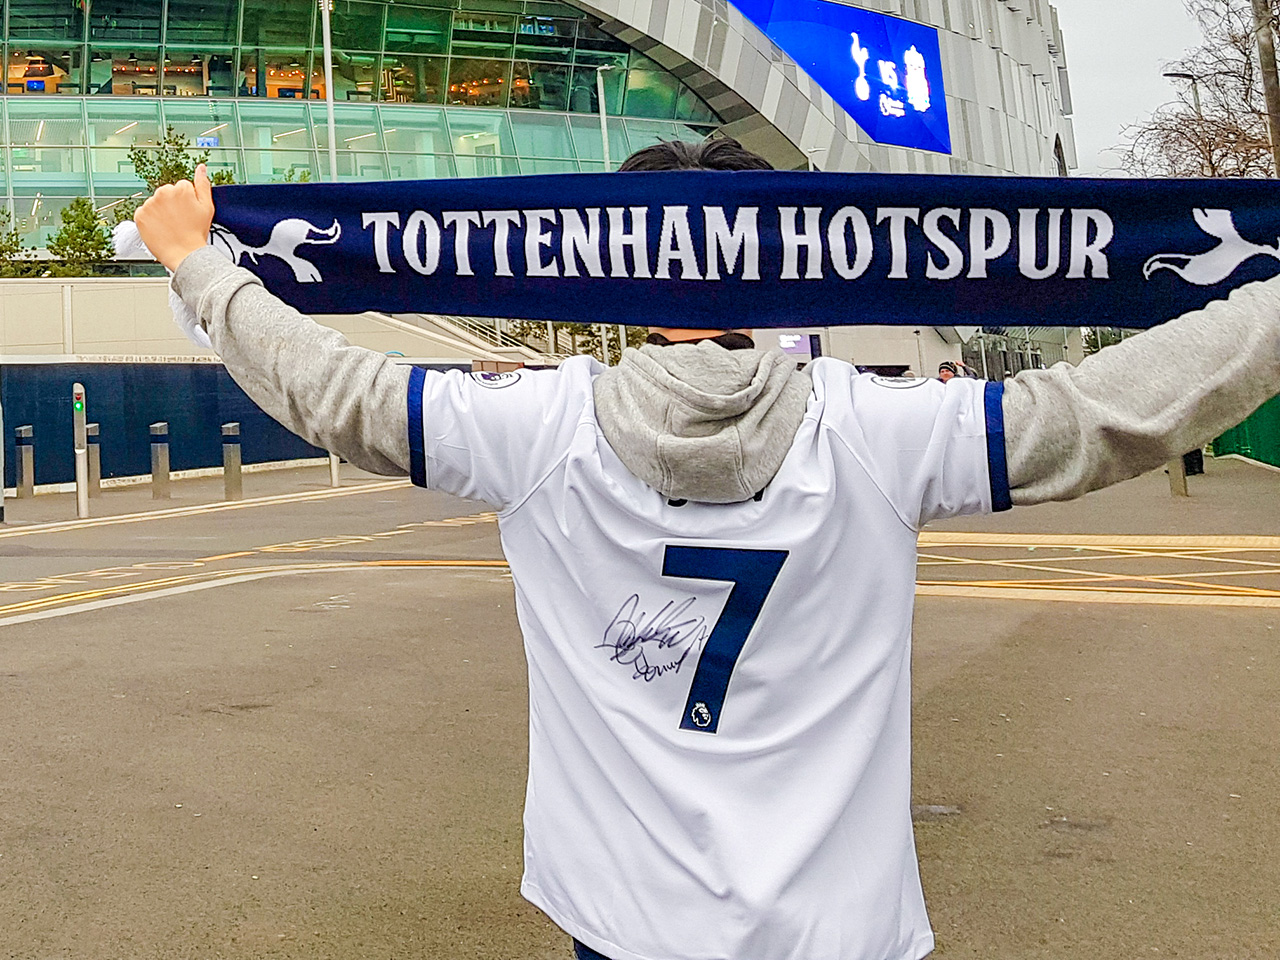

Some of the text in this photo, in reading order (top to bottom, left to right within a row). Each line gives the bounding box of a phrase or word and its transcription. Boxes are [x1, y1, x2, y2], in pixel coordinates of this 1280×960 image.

[361, 205, 1115, 281] TOTTENHAM HOTSPUR
[660, 543, 791, 736] 7
